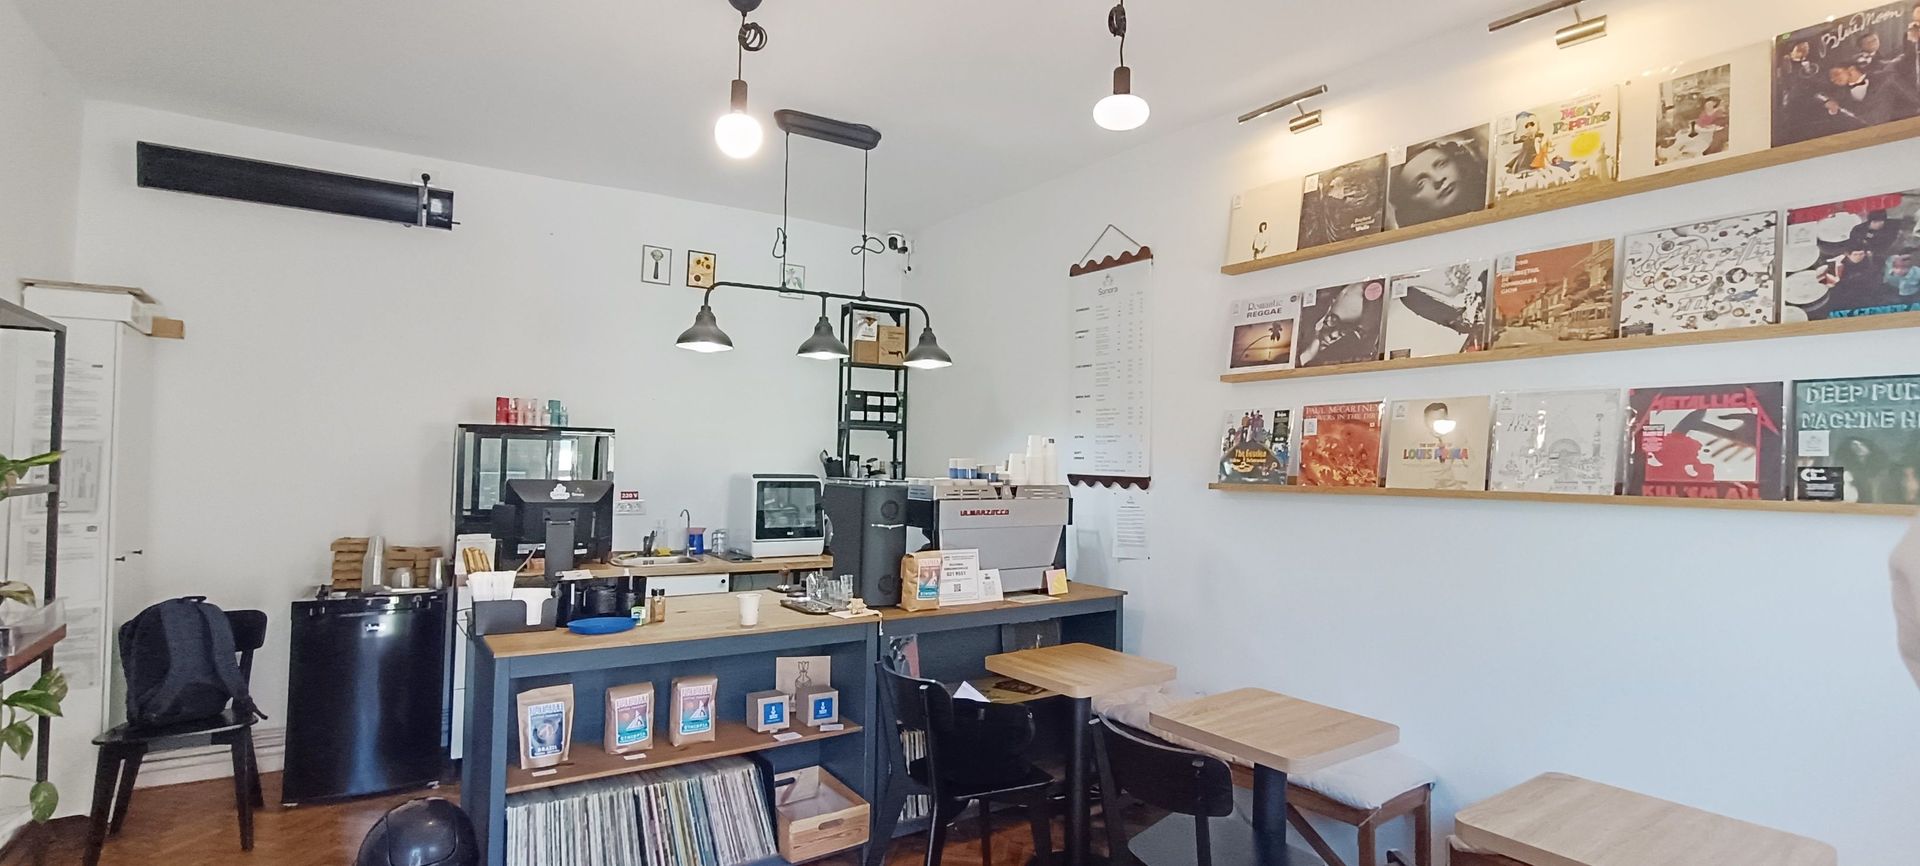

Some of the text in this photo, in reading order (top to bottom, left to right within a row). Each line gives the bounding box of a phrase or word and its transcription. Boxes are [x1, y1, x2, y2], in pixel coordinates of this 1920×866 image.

[1820, 8, 1904, 58] Blue Moon
[1098, 286, 1118, 296] Sonora
[1247, 307, 1283, 318] REGGAE
[1805, 385, 1867, 404] DEEP
[1306, 406, 1326, 415] PAUL
[1634, 386, 1780, 436] METALLICA
[1801, 408, 1896, 430] MACHINE
[1403, 448, 1433, 460] LOUIS
[1642, 484, 1677, 497] KILL
